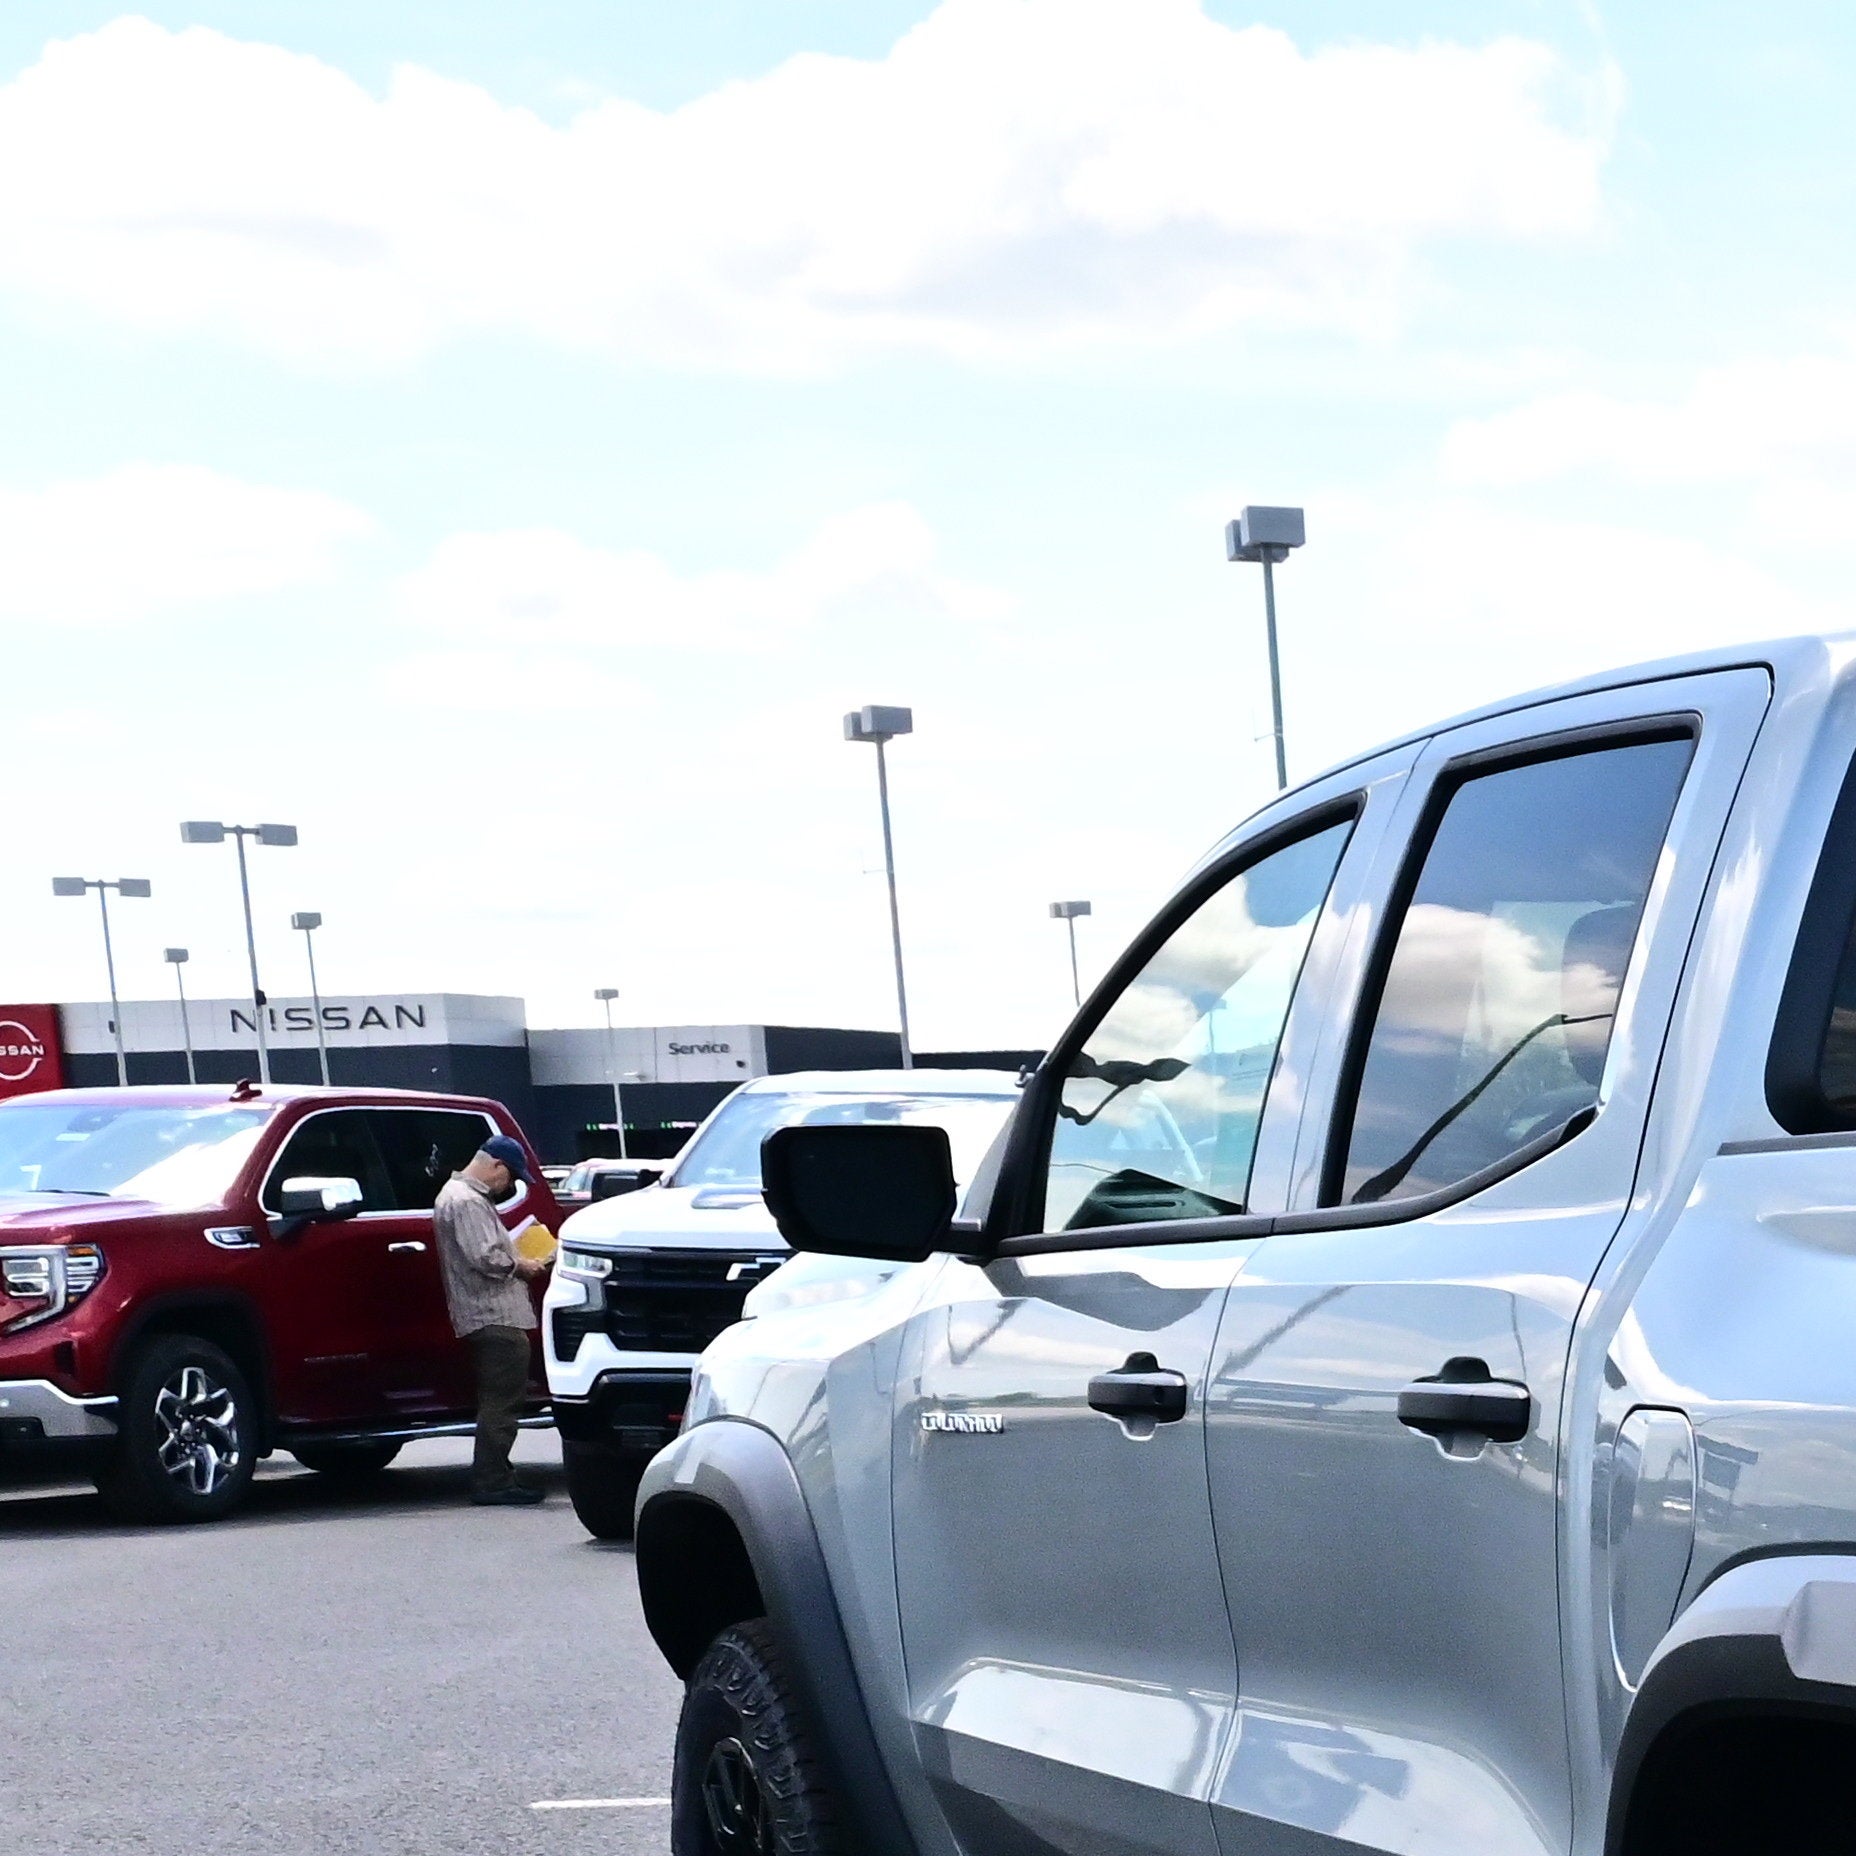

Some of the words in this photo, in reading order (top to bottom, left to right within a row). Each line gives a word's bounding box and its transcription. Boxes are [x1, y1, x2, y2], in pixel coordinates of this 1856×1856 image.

[230, 1004, 427, 1032] NISSAN
[0, 1045, 44, 1056] SSAN
[668, 1042, 730, 1055] Service
